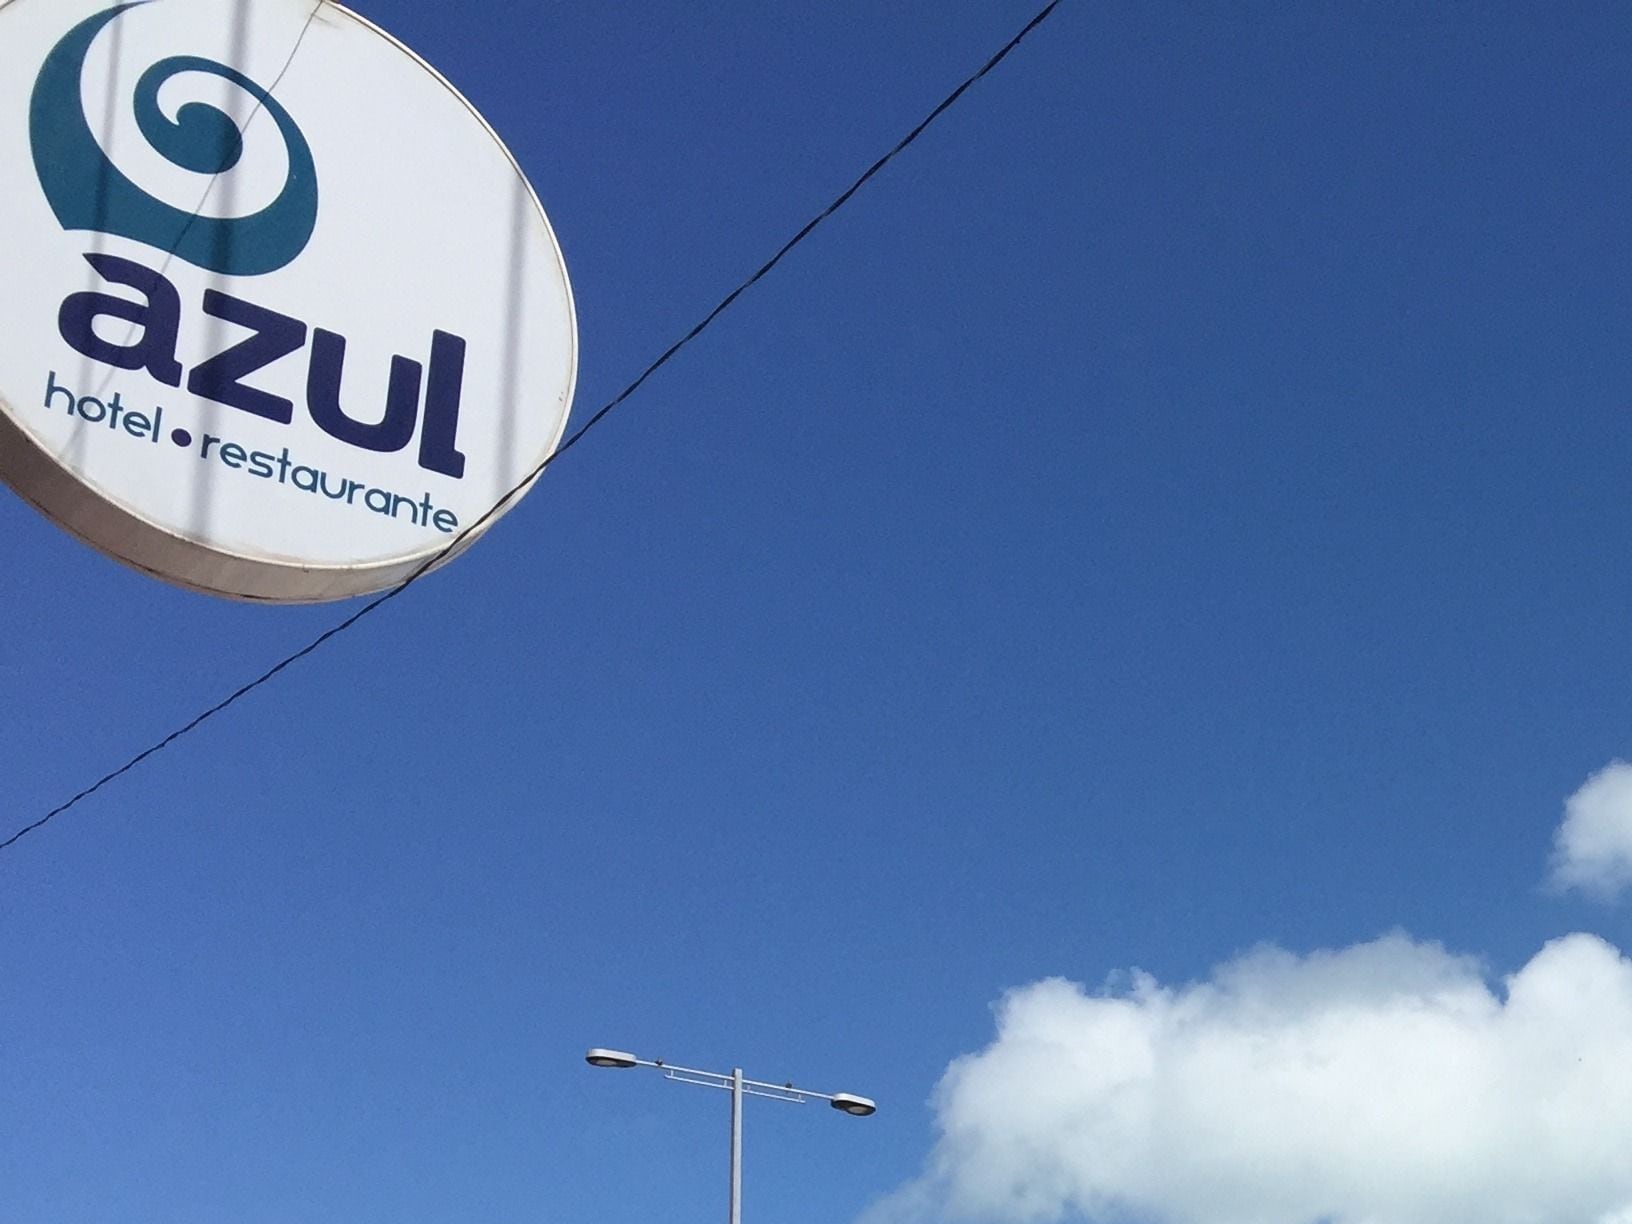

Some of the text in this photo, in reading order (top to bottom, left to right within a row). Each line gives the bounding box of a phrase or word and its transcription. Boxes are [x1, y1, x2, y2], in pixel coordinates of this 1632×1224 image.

[43, 371, 459, 533] hotel restaurante
[57, 252, 467, 479] azul
